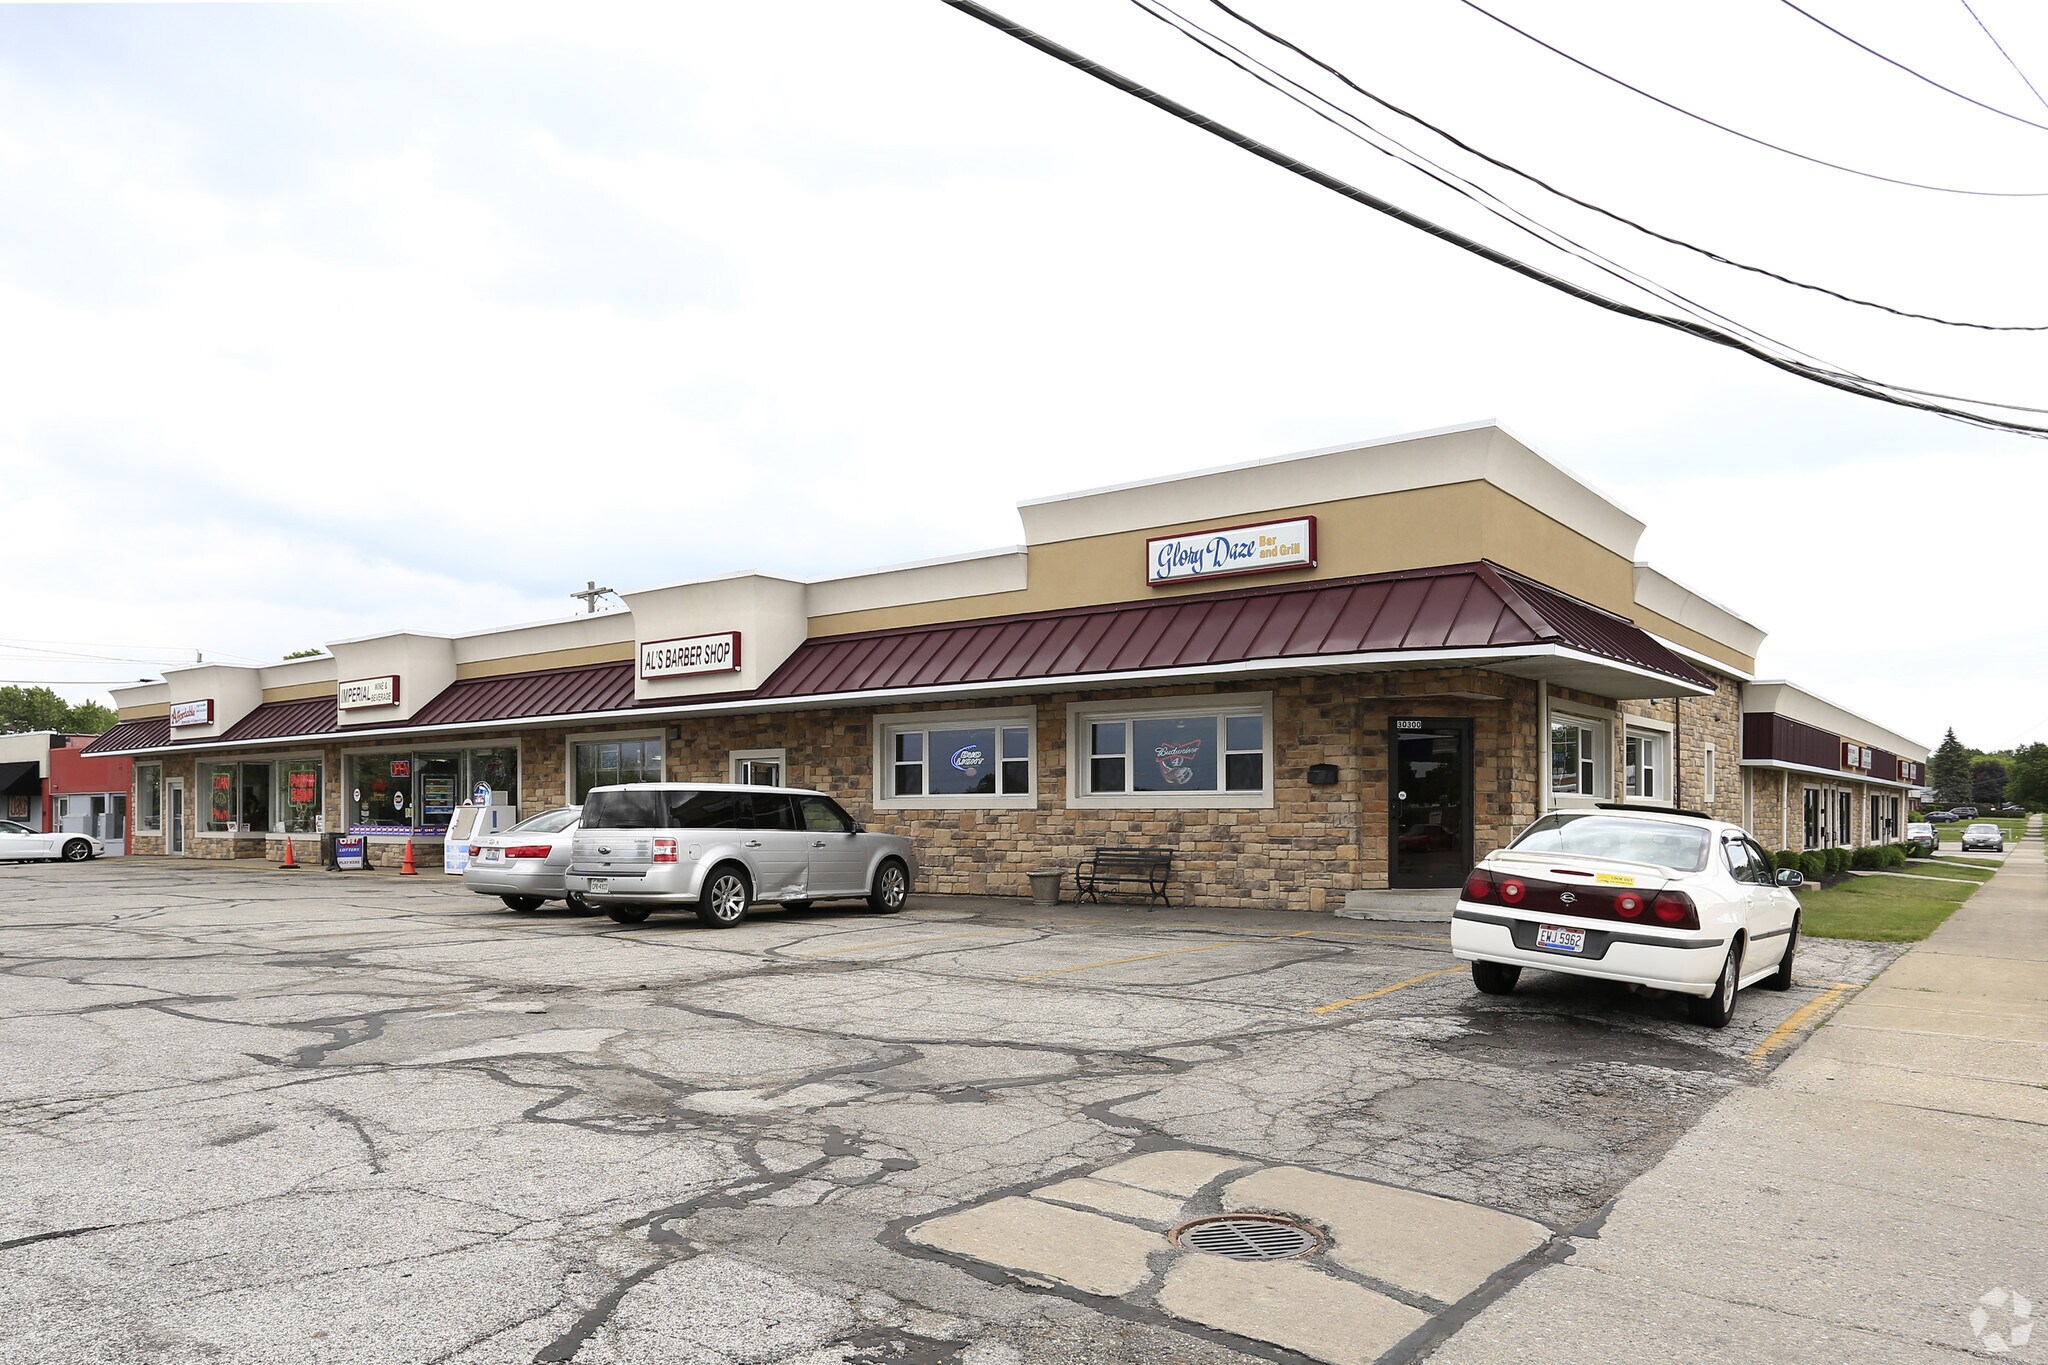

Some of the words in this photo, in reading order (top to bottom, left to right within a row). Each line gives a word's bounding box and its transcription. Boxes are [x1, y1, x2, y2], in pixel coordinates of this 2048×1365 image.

[1259, 535, 1277, 547] Bar
[1259, 545, 1278, 558] and
[1279, 542, 1300, 556] Grill
[1156, 541, 1204, 579] Glory
[1206, 536, 1257, 568] Daze
[644, 649, 664, 671] AL'S
[665, 645, 702, 669] BARBER
[704, 641, 731, 665] SHOP
[341, 686, 371, 704] IMPERIAL
[370, 691, 391, 703] BEVERAGE
[1397, 721, 1422, 729] 30300
[960, 750, 982, 759] BUD
[1155, 747, 1200, 757] Budweiser
[956, 757, 985, 766] LIGHT
[391, 762, 410, 776] OPEN
[1540, 930, 1557, 943] EWJ
[1560, 932, 1582, 947] 5962
